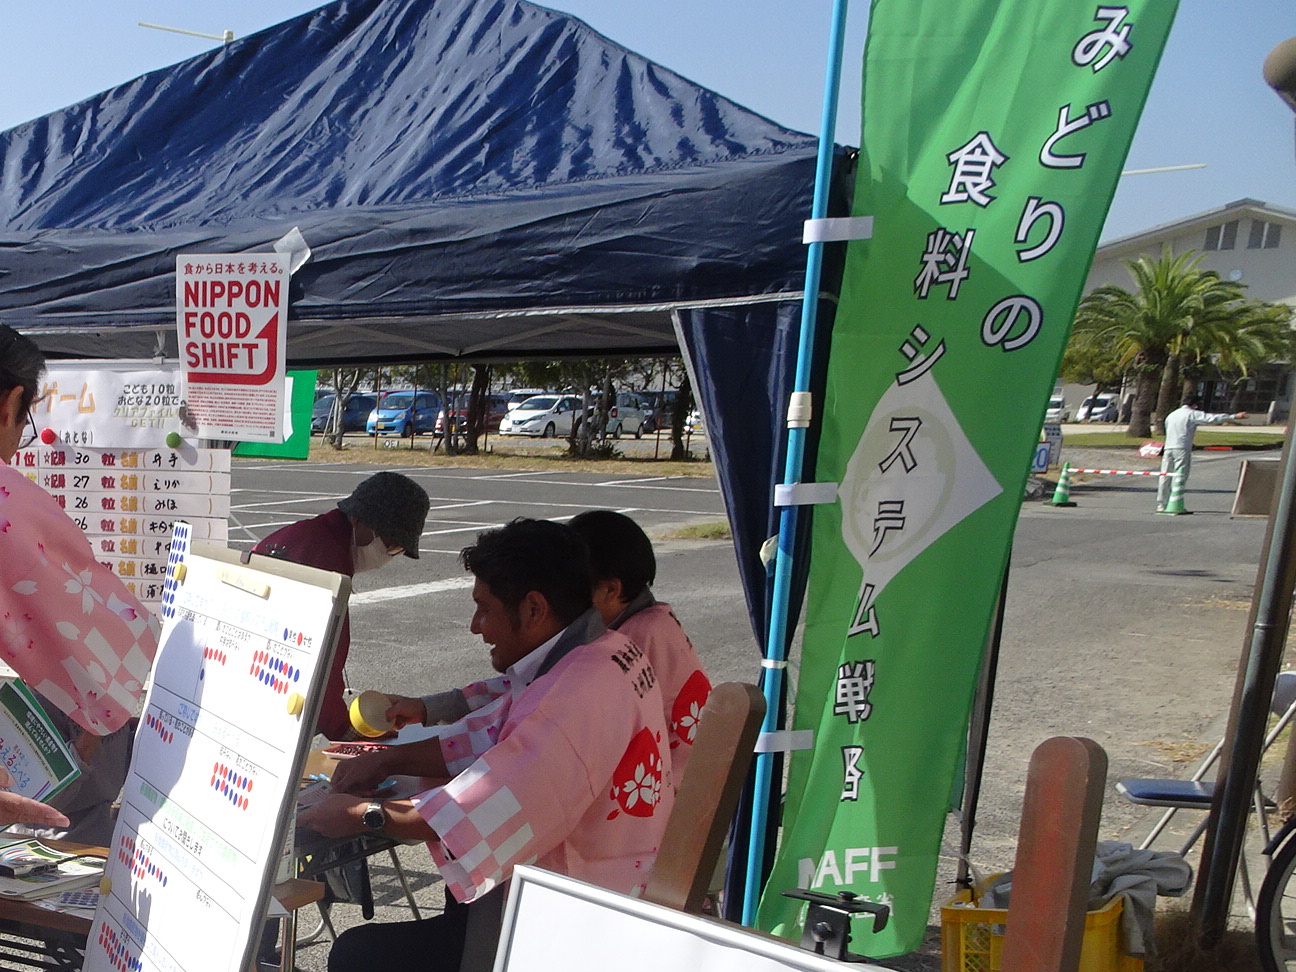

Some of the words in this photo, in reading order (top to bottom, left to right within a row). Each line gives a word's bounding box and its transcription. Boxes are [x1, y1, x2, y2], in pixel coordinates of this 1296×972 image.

[981, 5, 1134, 353] みどりの
[183, 262, 284, 275] 食から日本を考える。
[184, 280, 280, 308] NIPPON
[185, 312, 252, 339] FOOD
[186, 342, 259, 370] SHIFT
[122, 384, 175, 395] こども10粒
[74, 452, 90, 464] 30
[833, 131, 1009, 802] 食料システム戦略
[73, 475, 90, 488] 27
[74, 496, 89, 509] 26
[798, 846, 898, 889] MAFF
